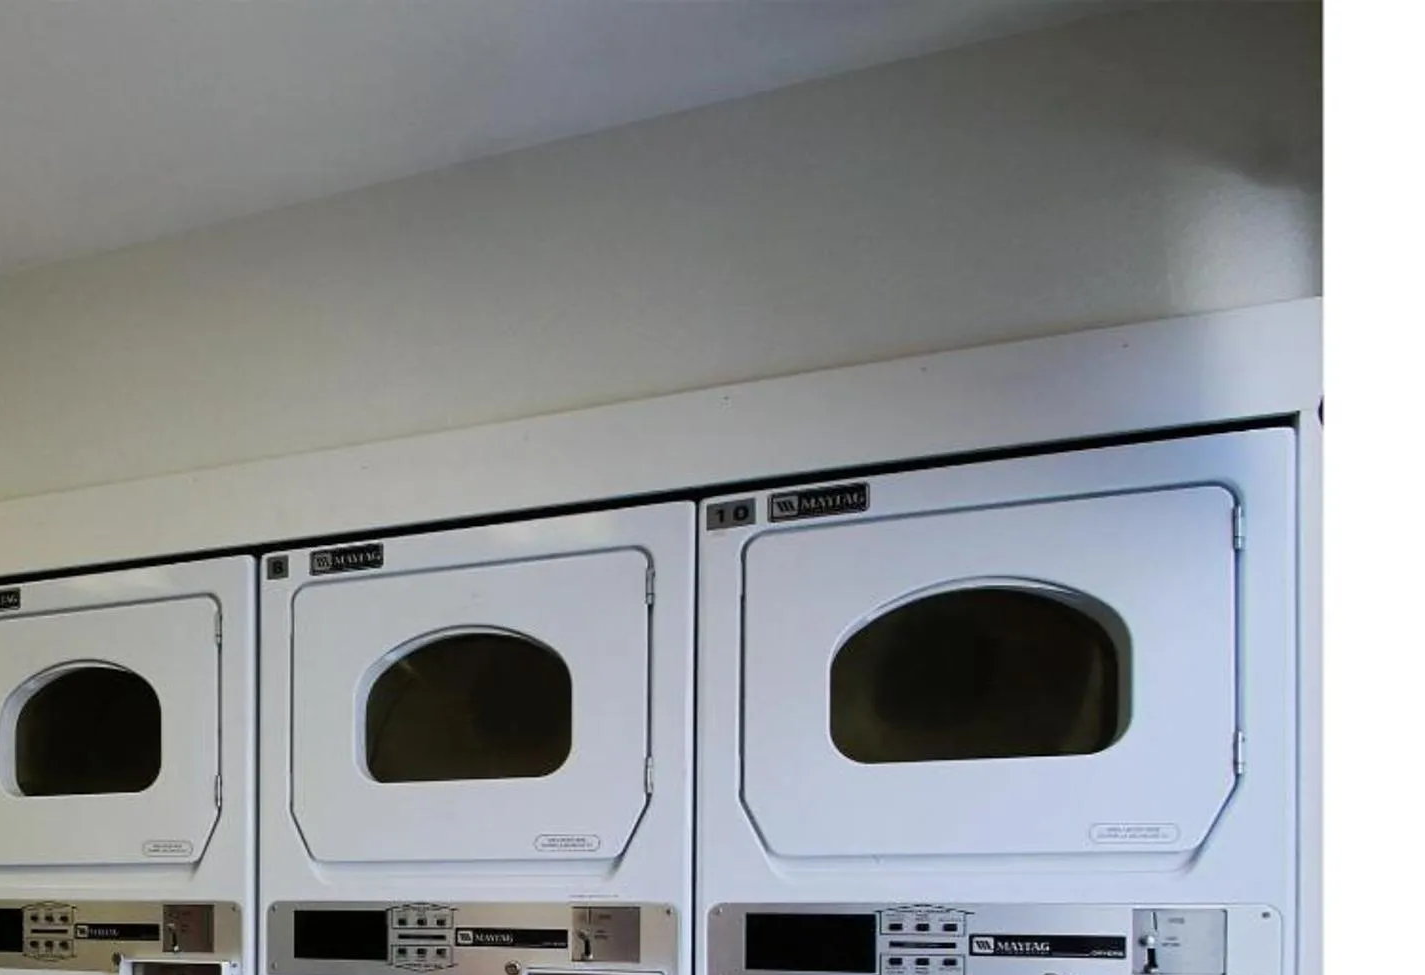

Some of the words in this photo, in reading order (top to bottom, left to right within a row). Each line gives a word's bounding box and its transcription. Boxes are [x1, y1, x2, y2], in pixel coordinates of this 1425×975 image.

[800, 491, 865, 511] MAYTAG
[716, 505, 749, 523] 10
[332, 551, 382, 566] MAYTAG
[995, 942, 1050, 952] MAYTAG
